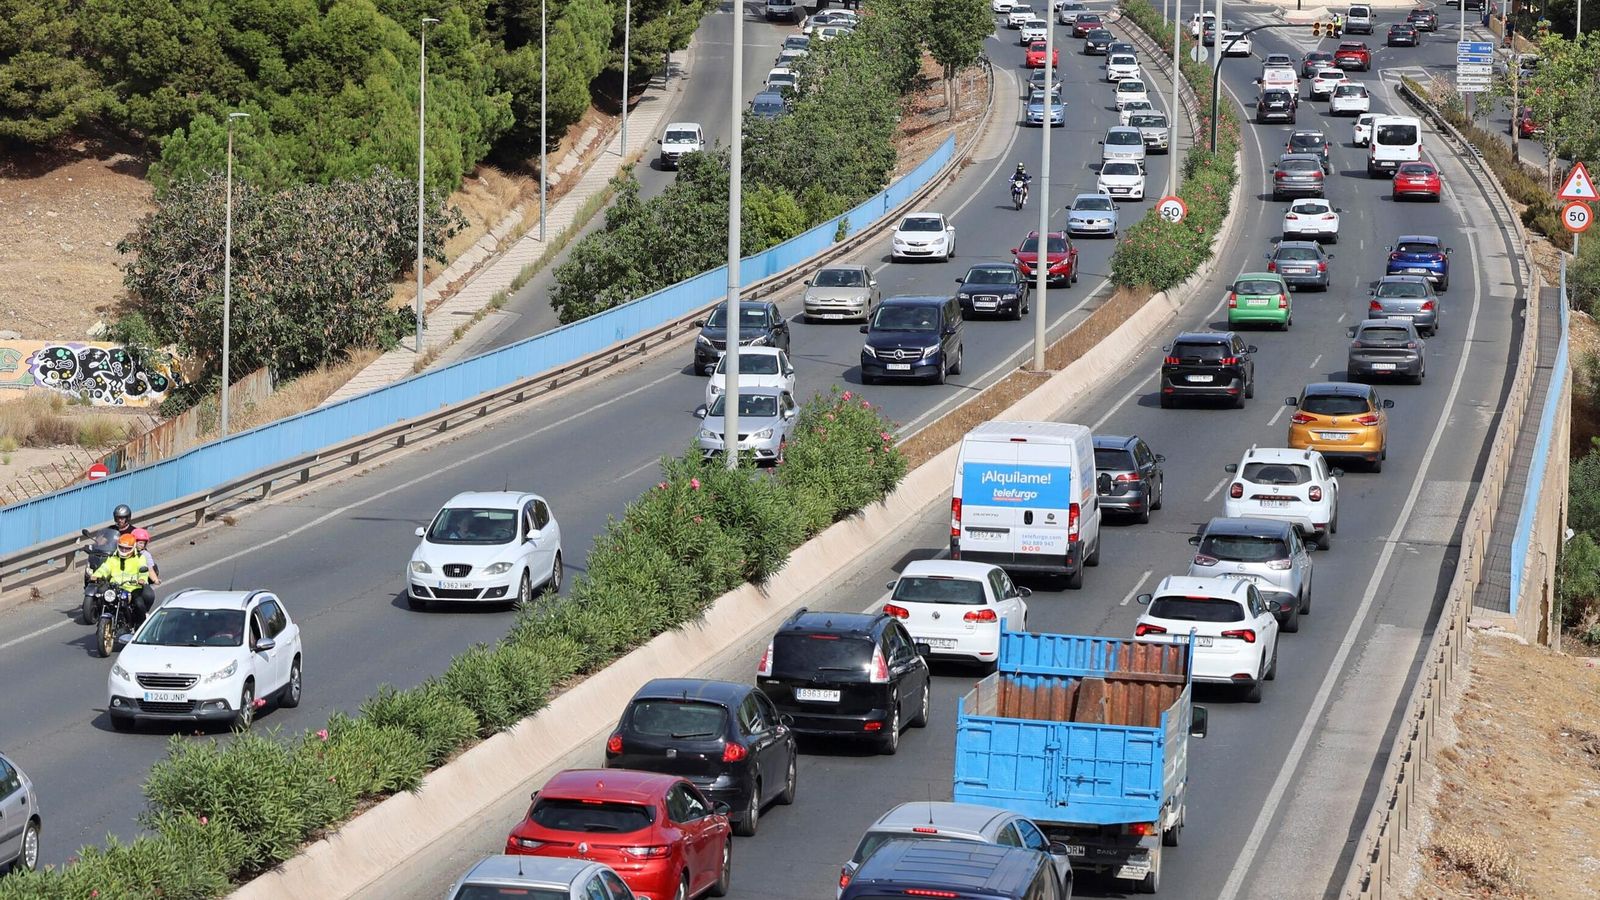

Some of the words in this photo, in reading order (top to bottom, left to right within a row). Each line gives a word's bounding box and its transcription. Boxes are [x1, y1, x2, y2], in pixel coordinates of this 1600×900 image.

[1163, 207, 1180, 217] 50
[1569, 212, 1586, 222] 50
[993, 488, 1038, 501] telefurgo
[1021, 533, 1062, 541] telefurgo.com
[150, 693, 169, 701] 1240
[170, 693, 185, 701] JNP
